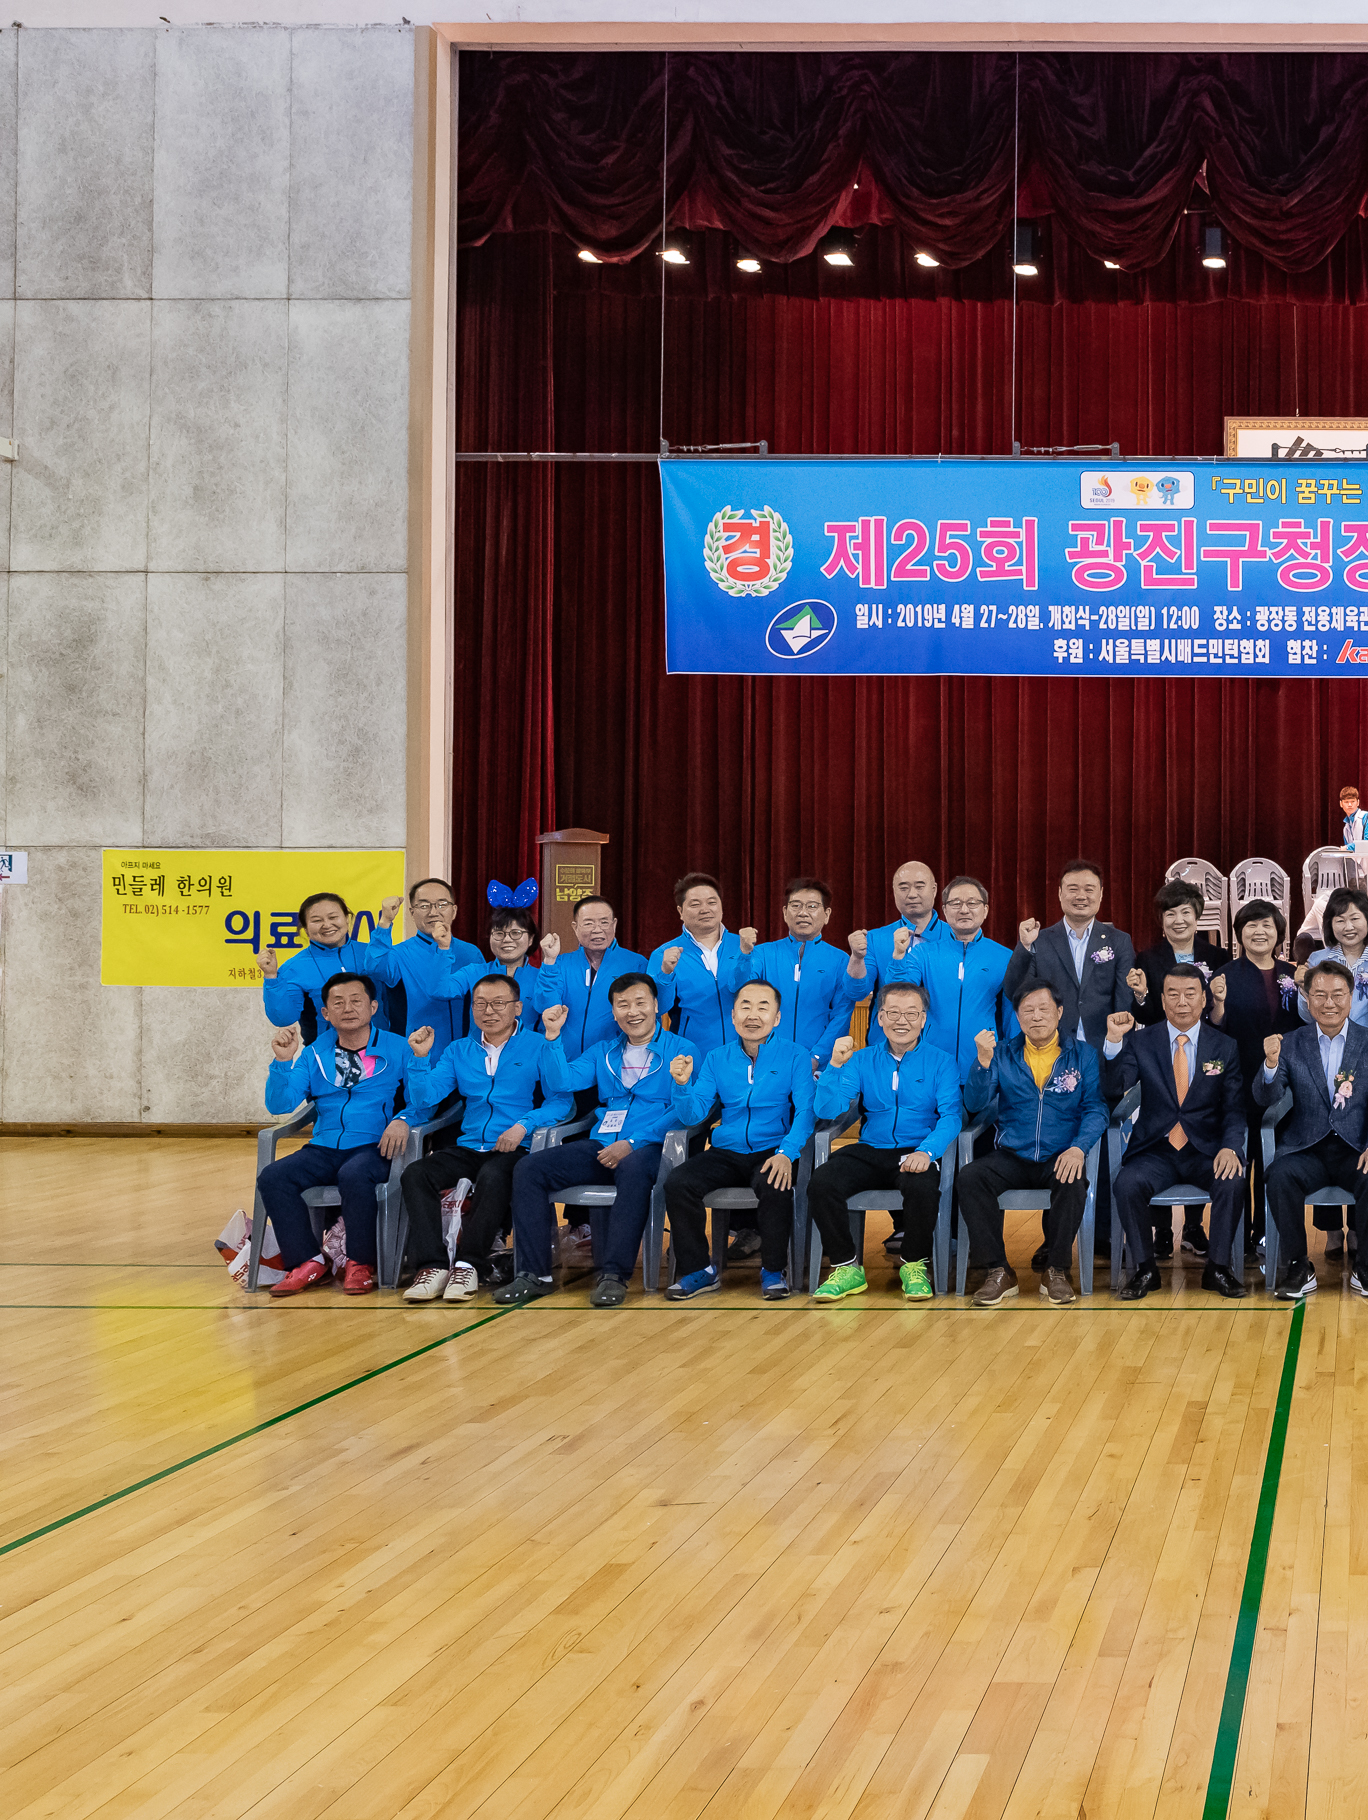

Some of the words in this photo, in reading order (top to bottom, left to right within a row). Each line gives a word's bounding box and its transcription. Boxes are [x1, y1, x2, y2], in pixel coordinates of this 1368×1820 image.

[1295, 477, 1362, 504] 꿈꾸는
[721, 520, 771, 582] 경
[821, 516, 1038, 590] 제25회
[856, 604, 882, 628] 일시
[897, 604, 945, 629] 2019년
[951, 604, 975, 629] 4월
[1161, 606, 1200, 630] 12:00
[1213, 606, 1242, 630] 장소
[1255, 606, 1298, 632] 광장동
[1053, 639, 1084, 664] 후원
[1098, 639, 1270, 664] 서울특별시배드민턴협회
[1286, 639, 1319, 665] 협찬
[121, 861, 140, 869] 아프지
[112, 874, 165, 897] 민들레
[176, 875, 232, 897] 한의원
